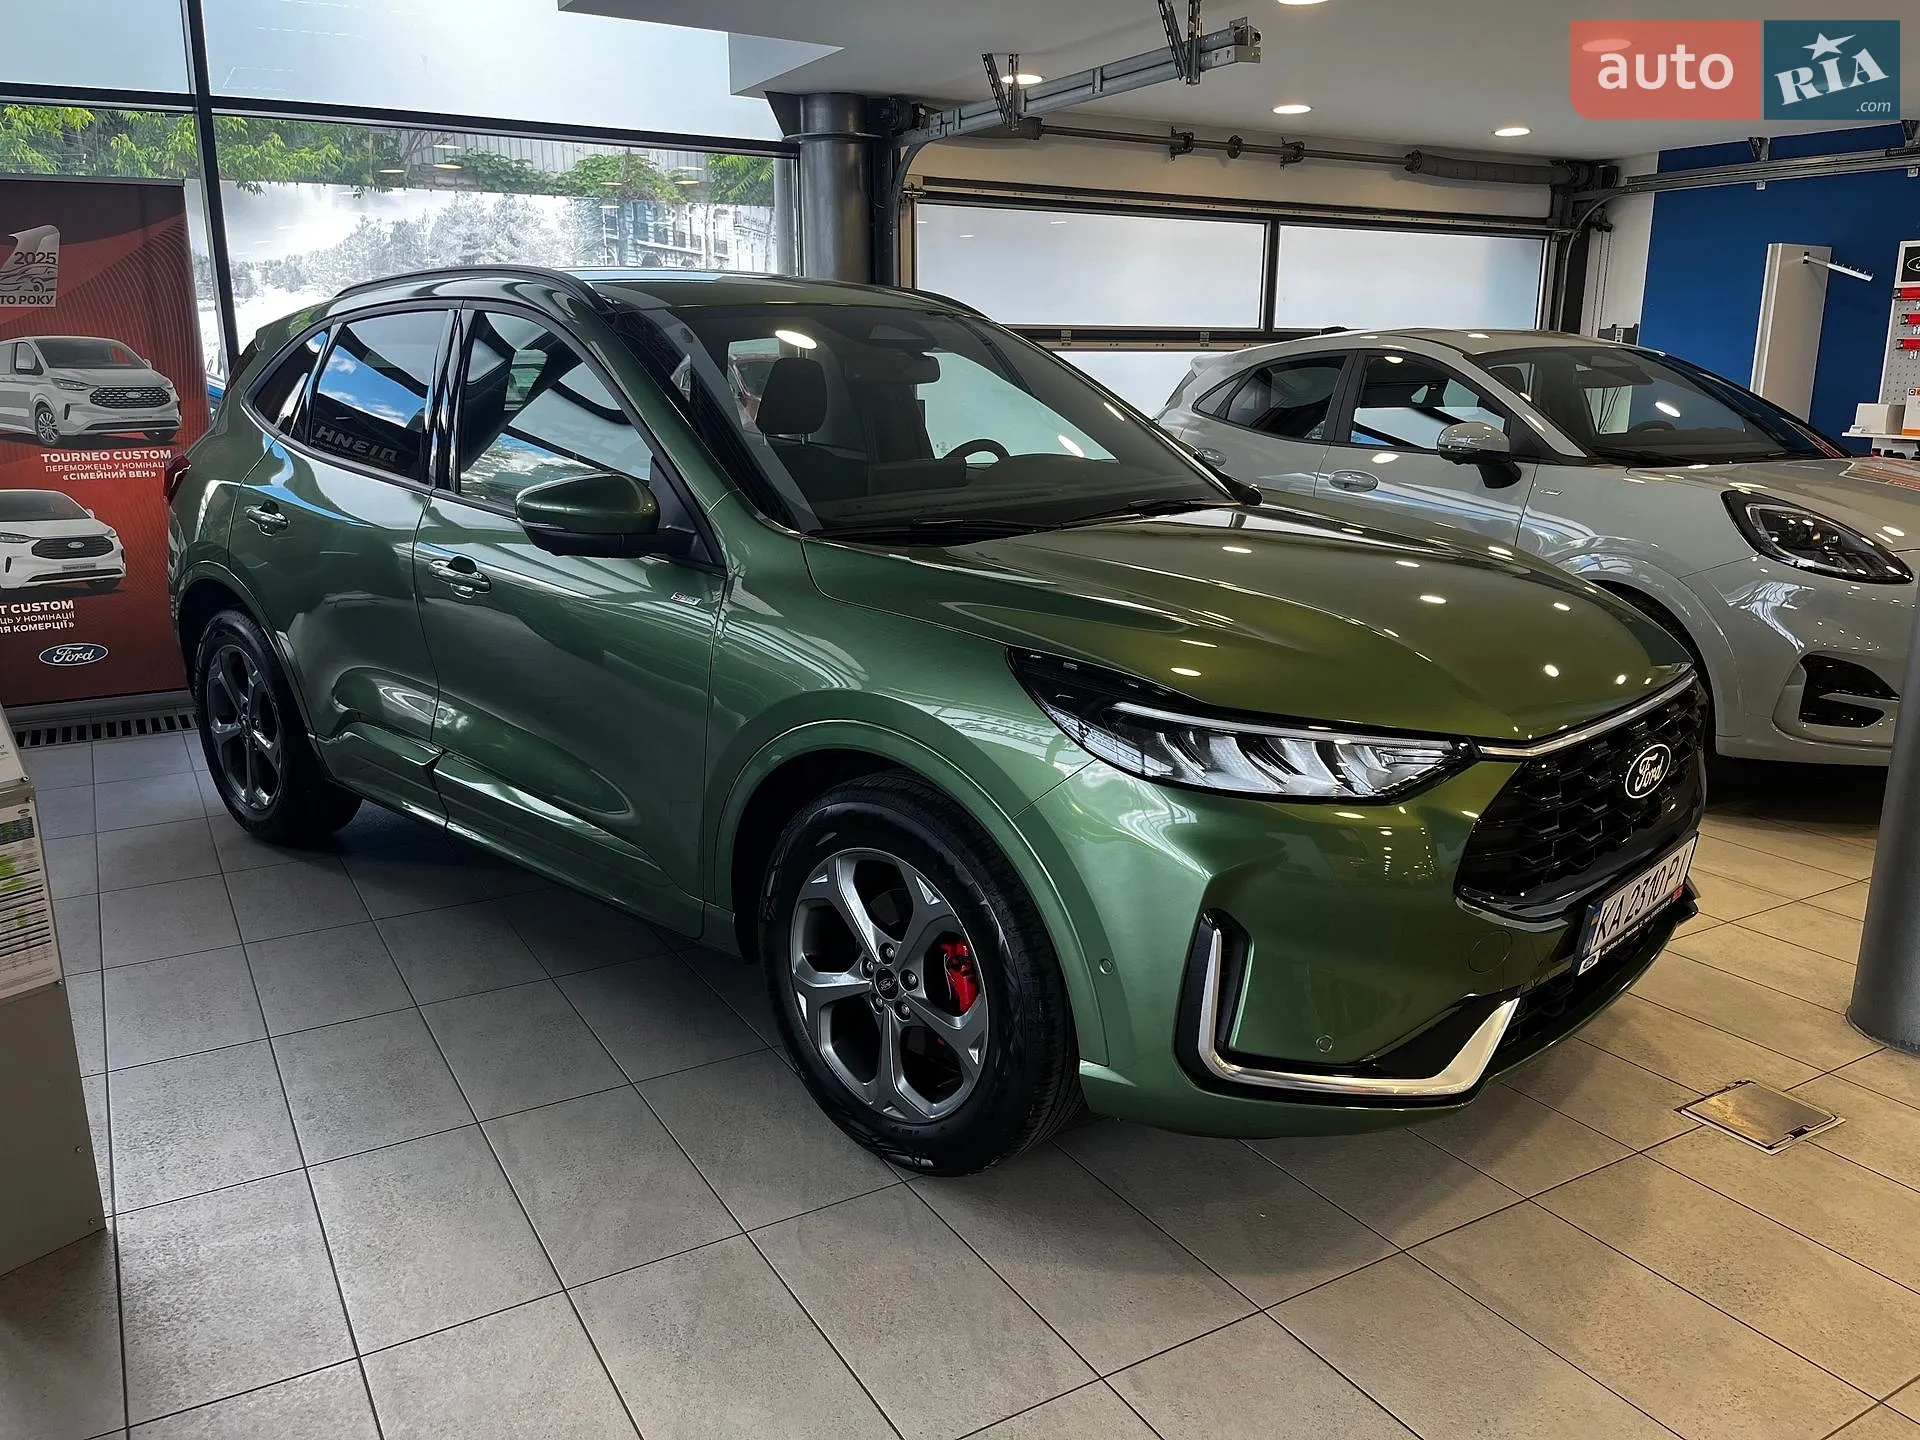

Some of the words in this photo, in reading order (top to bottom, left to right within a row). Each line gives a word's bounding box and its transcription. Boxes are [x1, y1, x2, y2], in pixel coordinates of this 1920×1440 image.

[14, 252, 57, 265] 2025
[18, 295, 54, 305] РОКУ
[40, 451, 110, 463] TOURNEO
[113, 449, 171, 460] CUSTOM
[45, 463, 112, 473] ПЕРЕМОЖЕЦЬ
[114, 462, 119, 470] У
[62, 469, 127, 481] «СІМЕЙНИЙ
[128, 470, 157, 478] ВЕН»
[10, 599, 74, 614] CUSTOM
[23, 610, 75, 623] НОМІНАЦІЇ
[13, 620, 75, 632] КОМЕРЦІЇ»
[53, 646, 95, 663] Ford
[1635, 753, 1664, 793] Ford
[1593, 895, 1625, 947] KA
[1624, 866, 1667, 924] 2310
